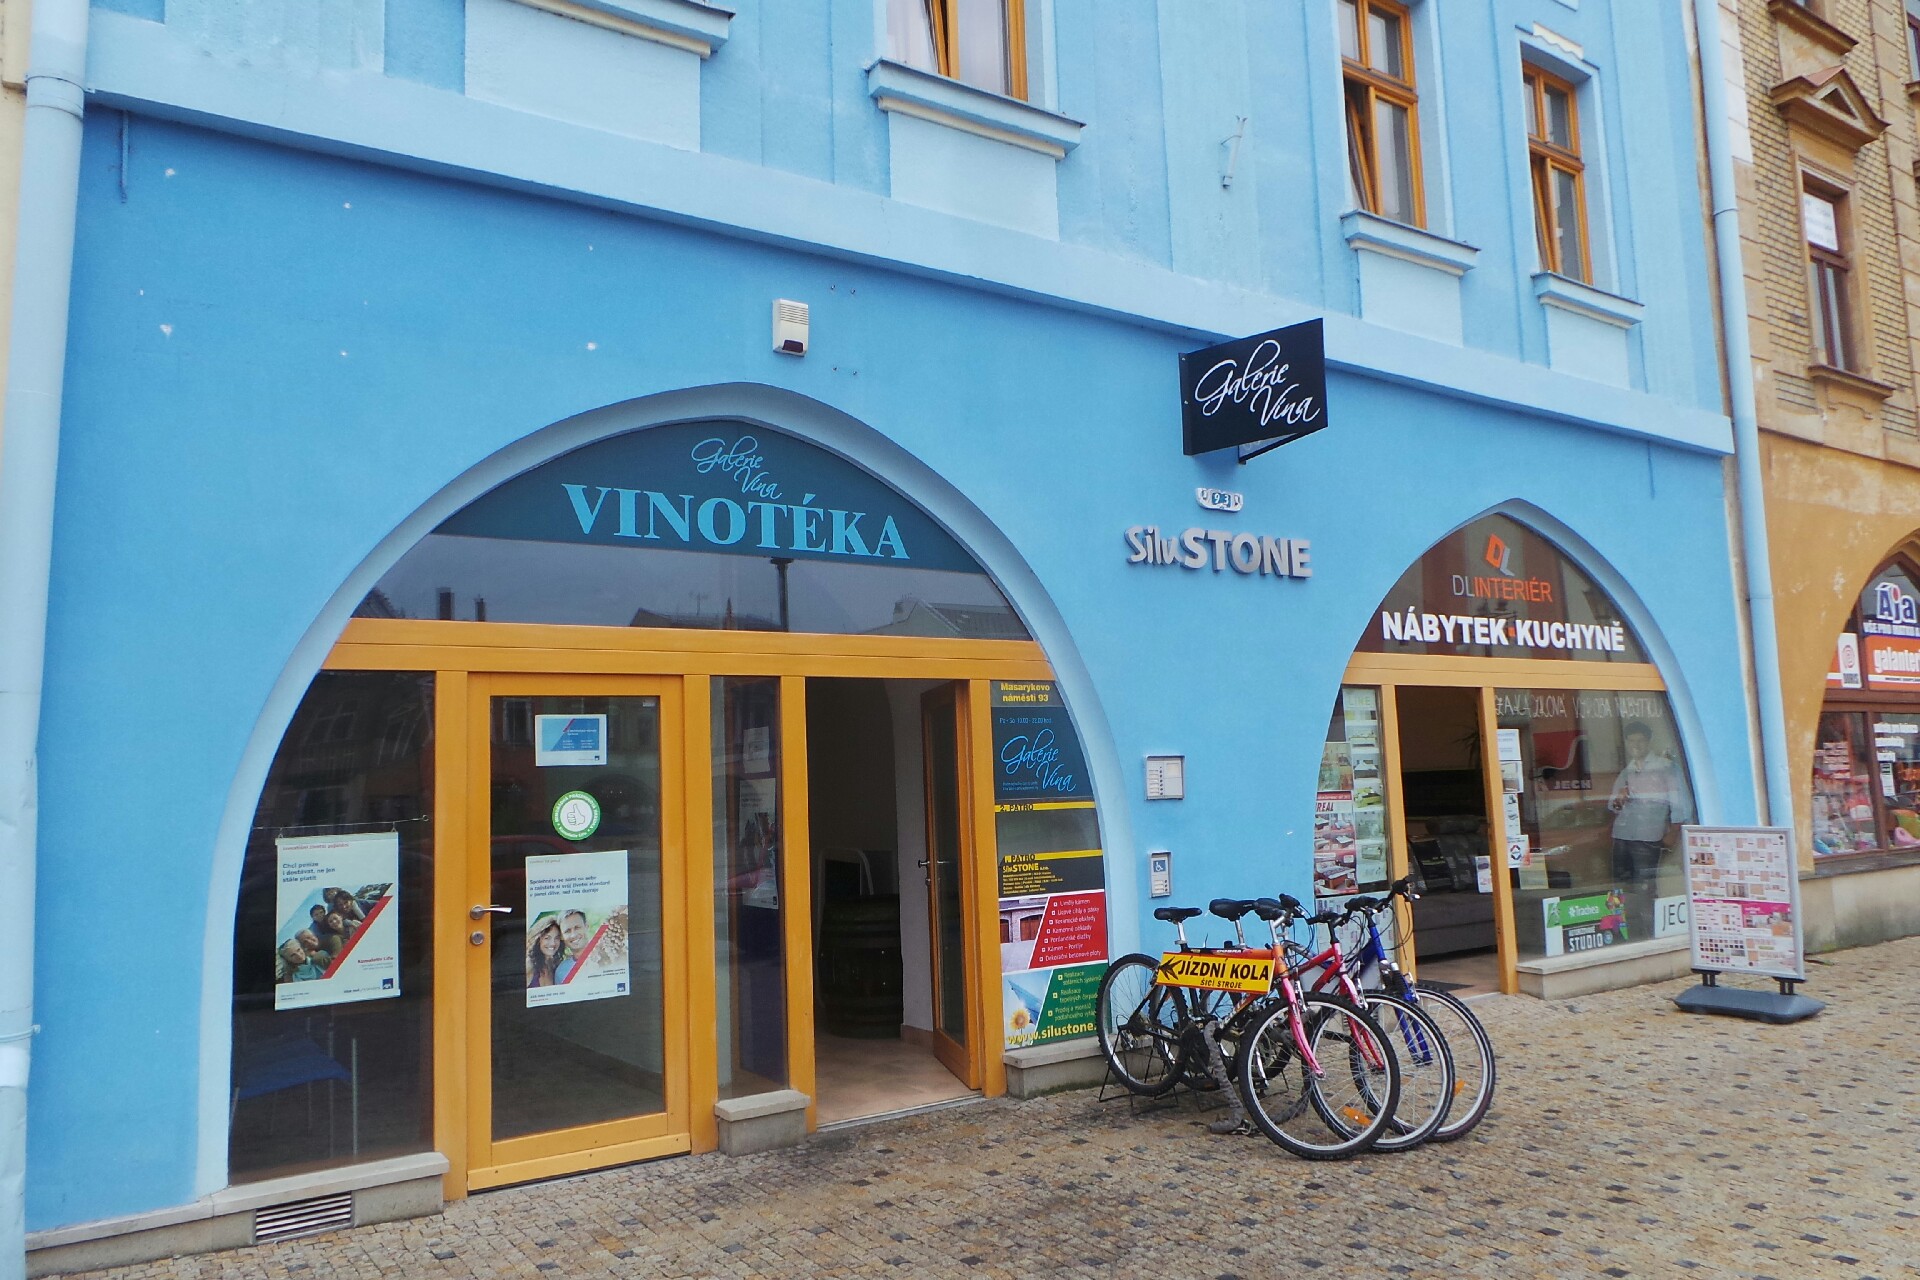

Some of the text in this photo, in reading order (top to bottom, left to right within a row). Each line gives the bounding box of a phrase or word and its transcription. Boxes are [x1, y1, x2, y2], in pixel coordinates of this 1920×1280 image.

[1195, 339, 1290, 416] Galerie
[691, 436, 763, 473] Galerie
[1214, 493, 1229, 505] 93
[561, 483, 910, 560] VINOTÉKA
[1125, 525, 1313, 579] SiluSTONE
[1452, 574, 1552, 602] DLINTERIÉR
[1382, 606, 1626, 652] NÁBYTEK KUCHYNĚ
[1872, 645, 1920, 673] galanter
[1000, 682, 1050, 693] Masarykovo
[1002, 693, 1049, 702] náměstí 93
[1001, 728, 1059, 775] Galerie
[1009, 804, 1034, 812] PATRO
[1011, 854, 1035, 863] PATRO
[1569, 933, 1604, 952] STUDIO
[1177, 957, 1269, 981] JÍZDNÍ KOLA
[1217, 981, 1242, 989] STROJE
